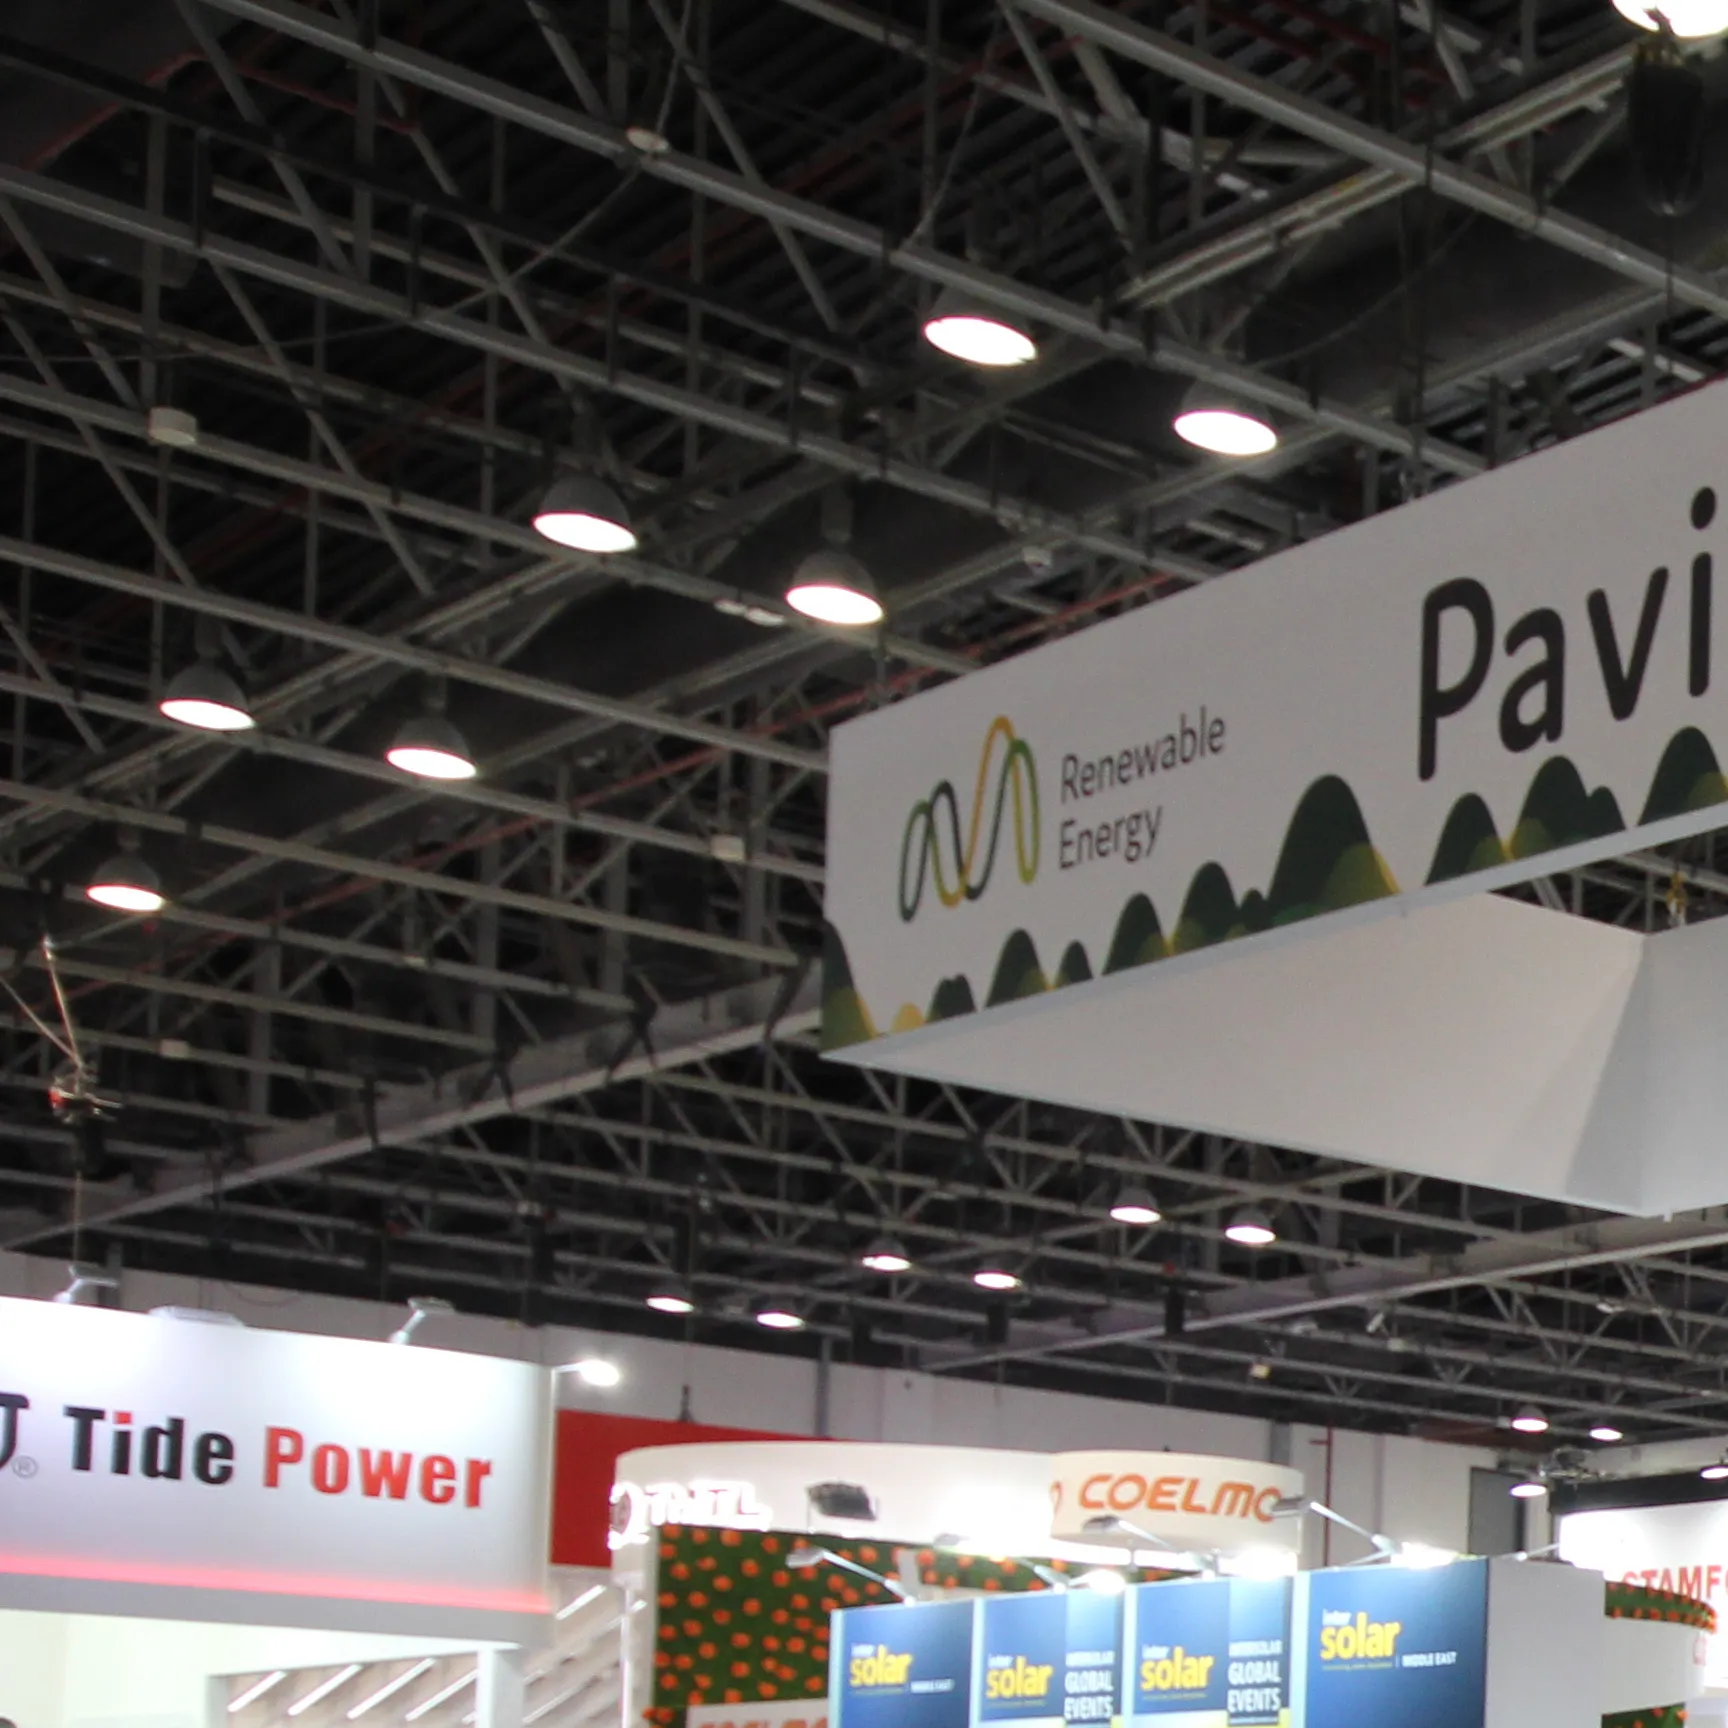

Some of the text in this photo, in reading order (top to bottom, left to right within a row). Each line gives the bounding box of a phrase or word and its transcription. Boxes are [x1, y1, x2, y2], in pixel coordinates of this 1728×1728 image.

[1059, 705, 1226, 803] Renewable
[1059, 806, 1163, 870] Energy
[62, 1404, 494, 1509] Tide Power
[1078, 1473, 1282, 1522] COELMO
[1320, 1611, 1401, 1660] solar
[850, 1644, 914, 1687] solar
[986, 1655, 1053, 1699] solar
[1141, 1646, 1214, 1691] solar
[1228, 1661, 1282, 1685] GLOBAL
[1435, 1651, 1458, 1665] EAST
[1064, 1670, 1114, 1694] GLOBAL
[1227, 1687, 1281, 1713] EVENTS
[1063, 1697, 1113, 1720] EVENTS
